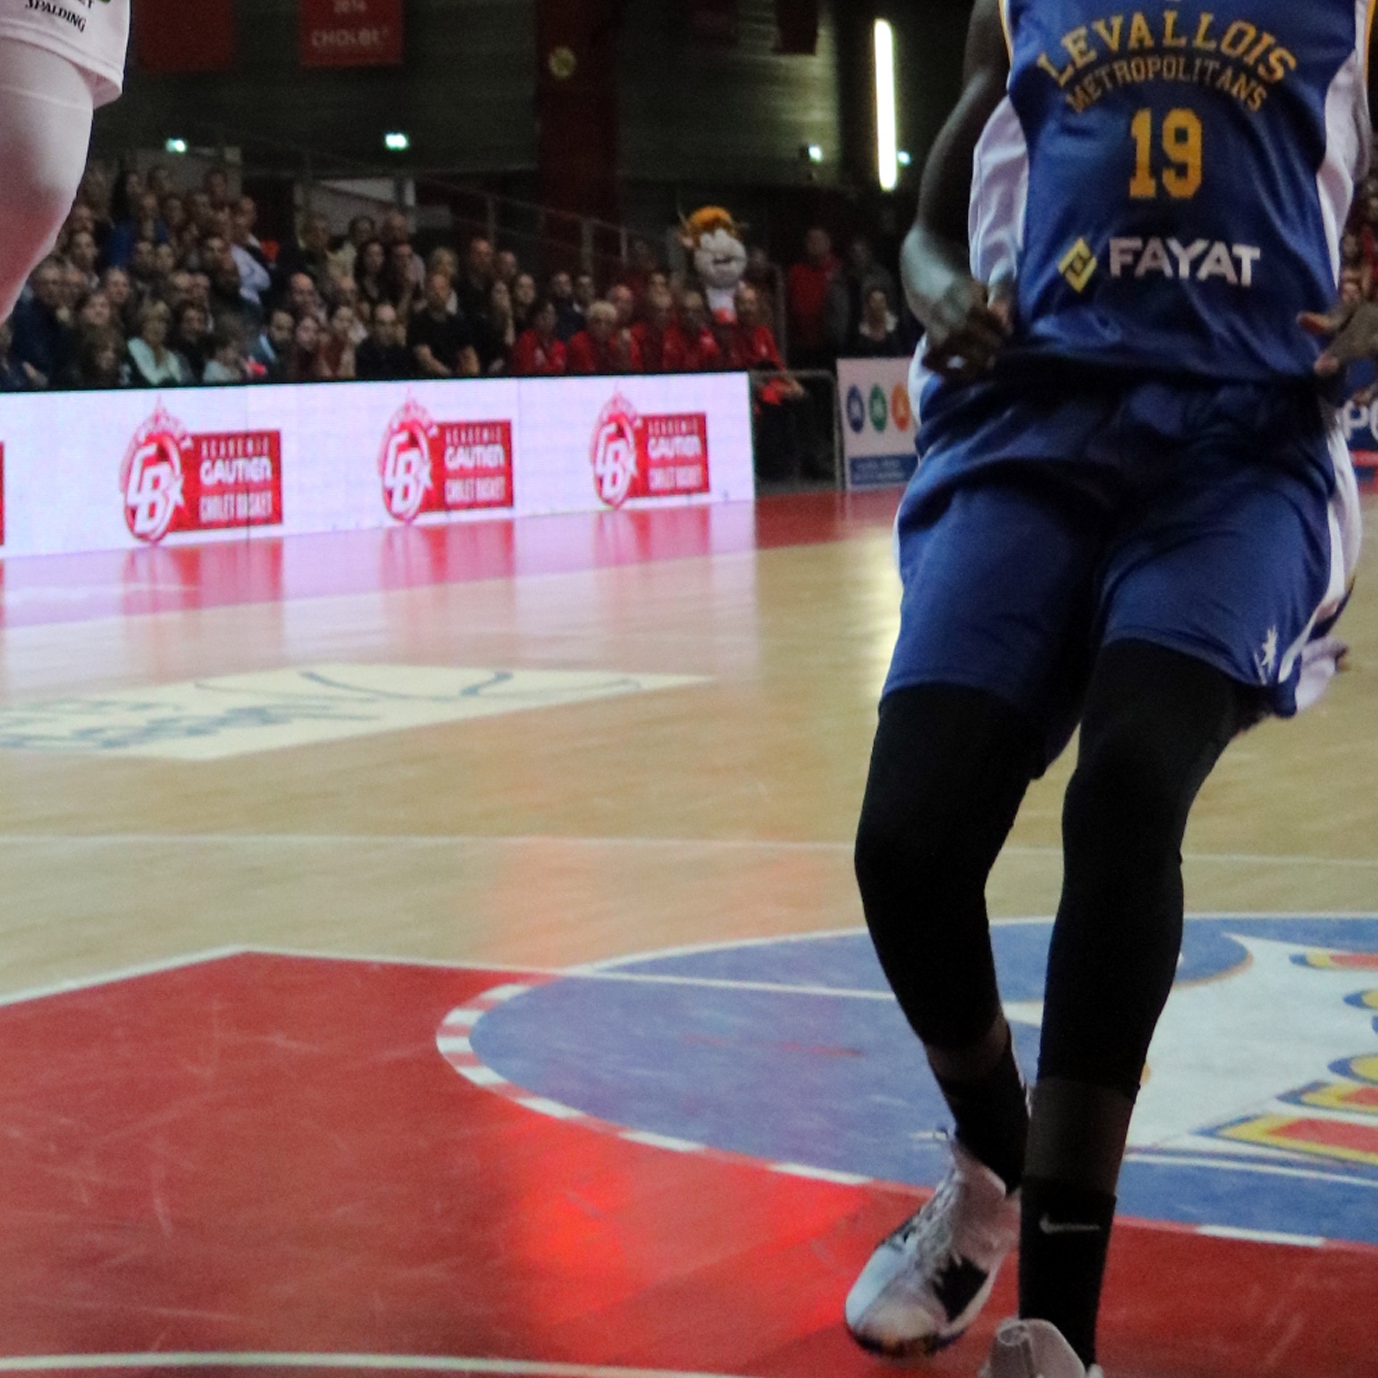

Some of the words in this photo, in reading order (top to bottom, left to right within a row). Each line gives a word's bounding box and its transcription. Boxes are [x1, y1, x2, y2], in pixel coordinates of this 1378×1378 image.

[1037, 9, 1298, 87] LEVALLOIS
[1066, 54, 1268, 114] METROPOLITANS
[1129, 108, 1203, 199] 19
[1109, 237, 1261, 287] FAYAT
